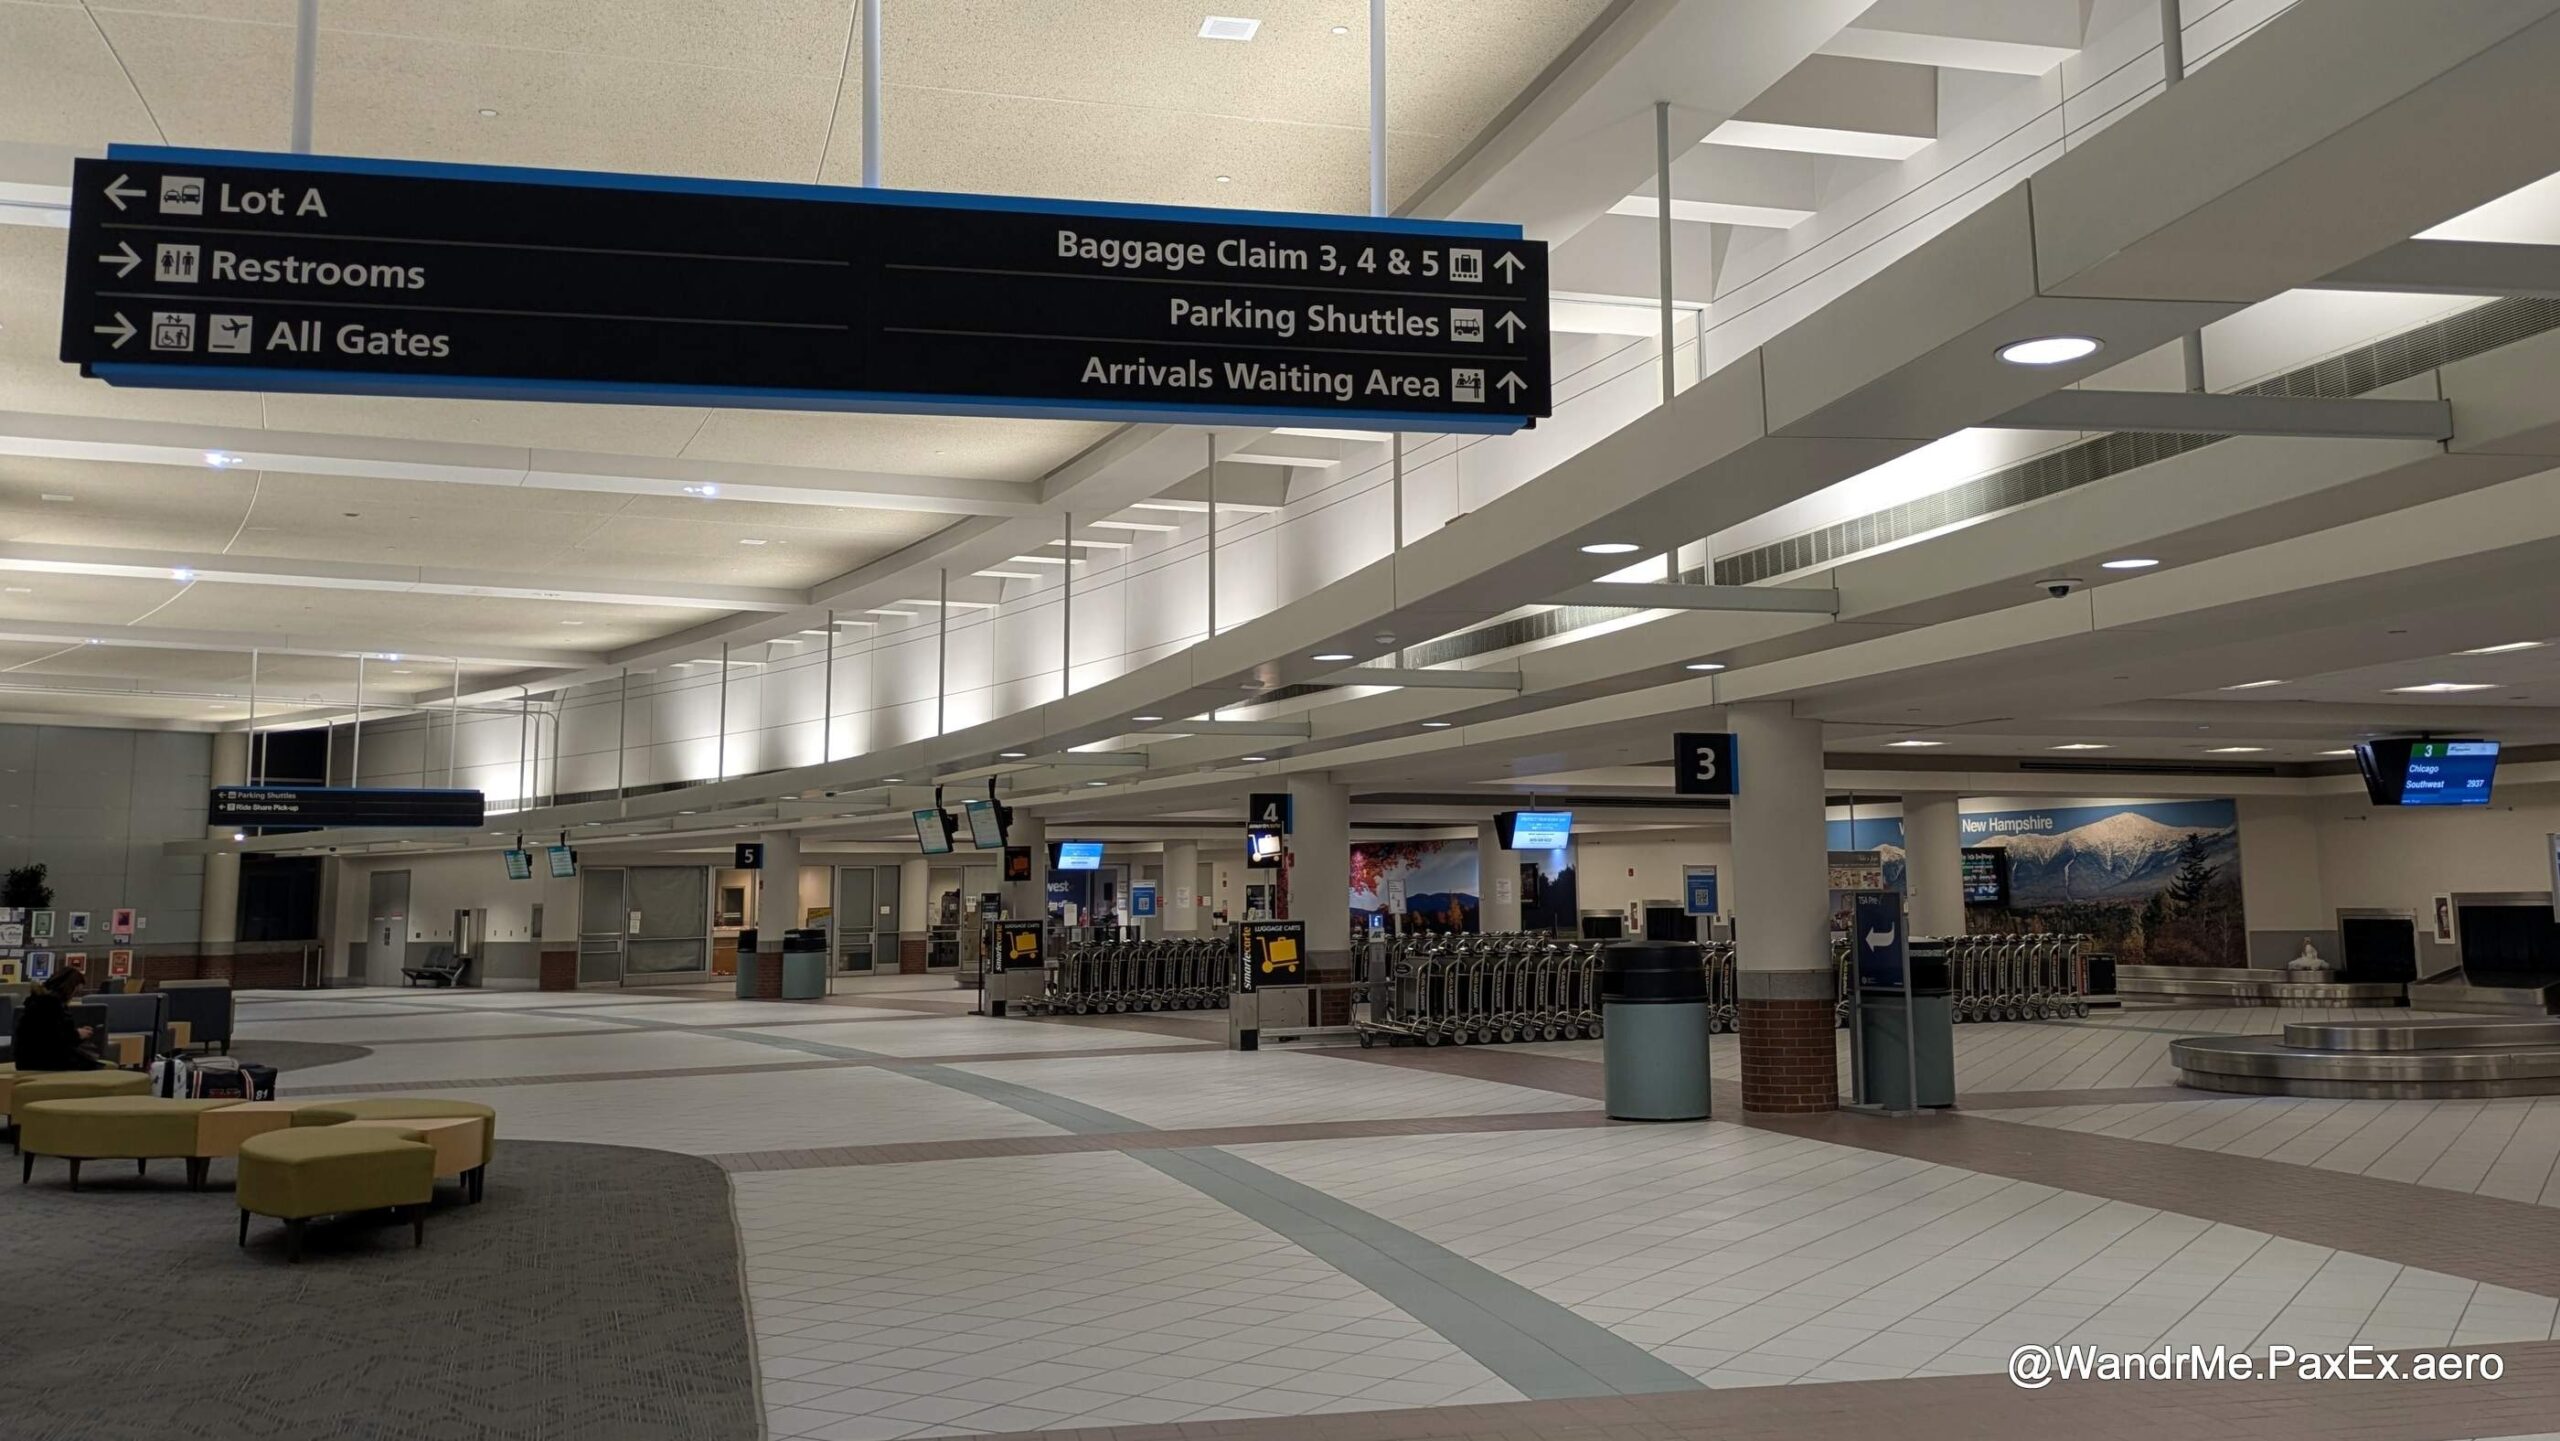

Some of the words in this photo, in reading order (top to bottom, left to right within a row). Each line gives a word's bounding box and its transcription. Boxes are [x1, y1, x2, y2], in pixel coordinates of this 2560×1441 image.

[220, 183, 285, 215] Lot
[296, 187, 328, 218] A
[1057, 230, 1206, 271] Baggage
[1217, 239, 1308, 270] Claim
[1319, 245, 1347, 276] 3,
[1357, 247, 1377, 274] 4
[1387, 249, 1412, 276] &
[1422, 250, 1440, 276] 5
[212, 250, 425, 290] Restrooms
[1170, 298, 1296, 338] Parking
[1308, 304, 1440, 337] Shuttles
[265, 321, 321, 353] All
[336, 325, 450, 358] Gates
[1081, 356, 1214, 388] Arrivals
[1224, 362, 1353, 401] Waiting
[1364, 368, 1440, 398] Area
[1696, 747, 1716, 781] 3
[2424, 744, 2433, 758] 3
[2408, 764, 2440, 775] Chicago
[237, 791, 266, 800] Parking
[2405, 779, 2445, 789] Southwest
[2466, 779, 2485, 788] 2937
[236, 803, 252, 811] Ride
[273, 804, 299, 812] Pick-up
[1262, 802, 1279, 822] 4
[1962, 818, 1987, 833] New
[1988, 815, 2053, 835] Hampshire
[744, 848, 754, 864] 5
[1242, 926, 1252, 991] smartecarte
